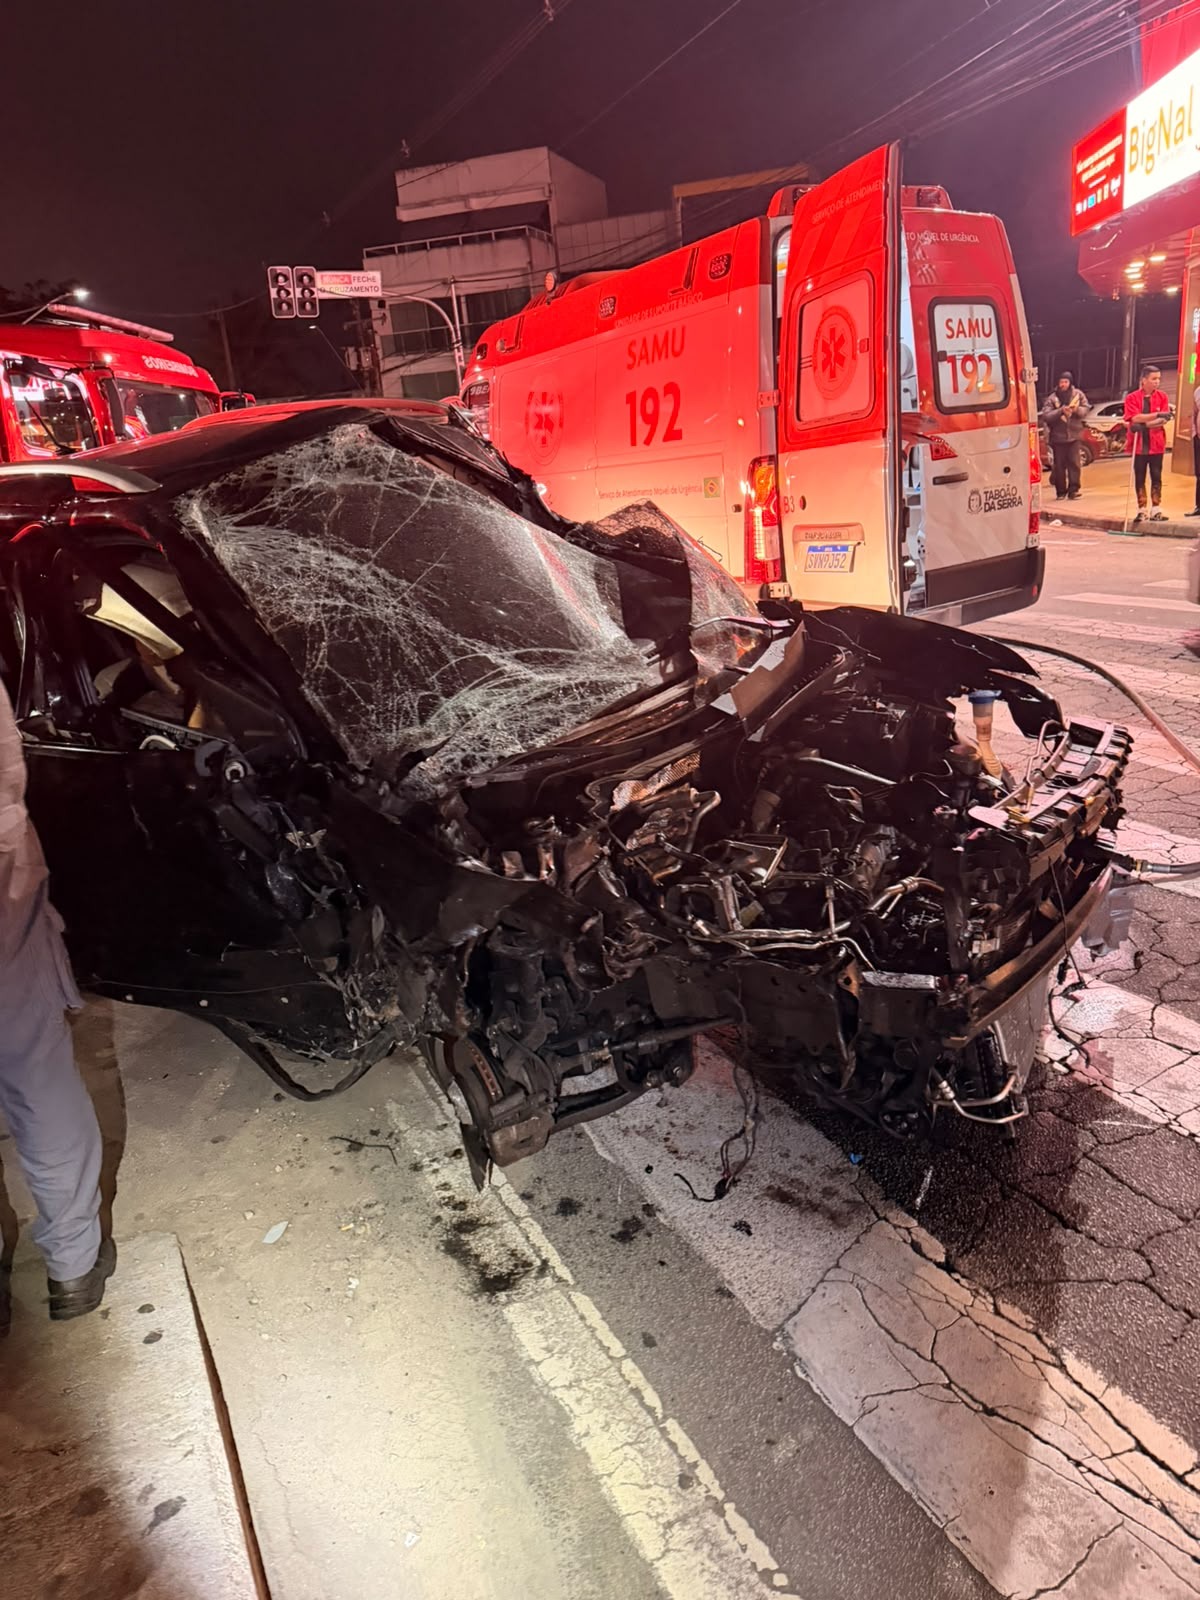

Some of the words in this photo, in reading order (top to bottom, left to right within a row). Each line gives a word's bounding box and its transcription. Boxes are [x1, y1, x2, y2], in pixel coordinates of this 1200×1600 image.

[1128, 84, 1193, 175] BigNal
[941, 232, 949, 241] DE
[330, 285, 380, 293] CRUZAMENTO
[352, 275, 377, 283] FECHE
[945, 317, 993, 339] SAMU
[626, 325, 686, 370] SAMU
[946, 353, 996, 394] 192
[625, 381, 683, 447] 192
[983, 483, 1018, 502] TABOÃO
[983, 501, 996, 513] DA
[997, 495, 1023, 510] SERRA
